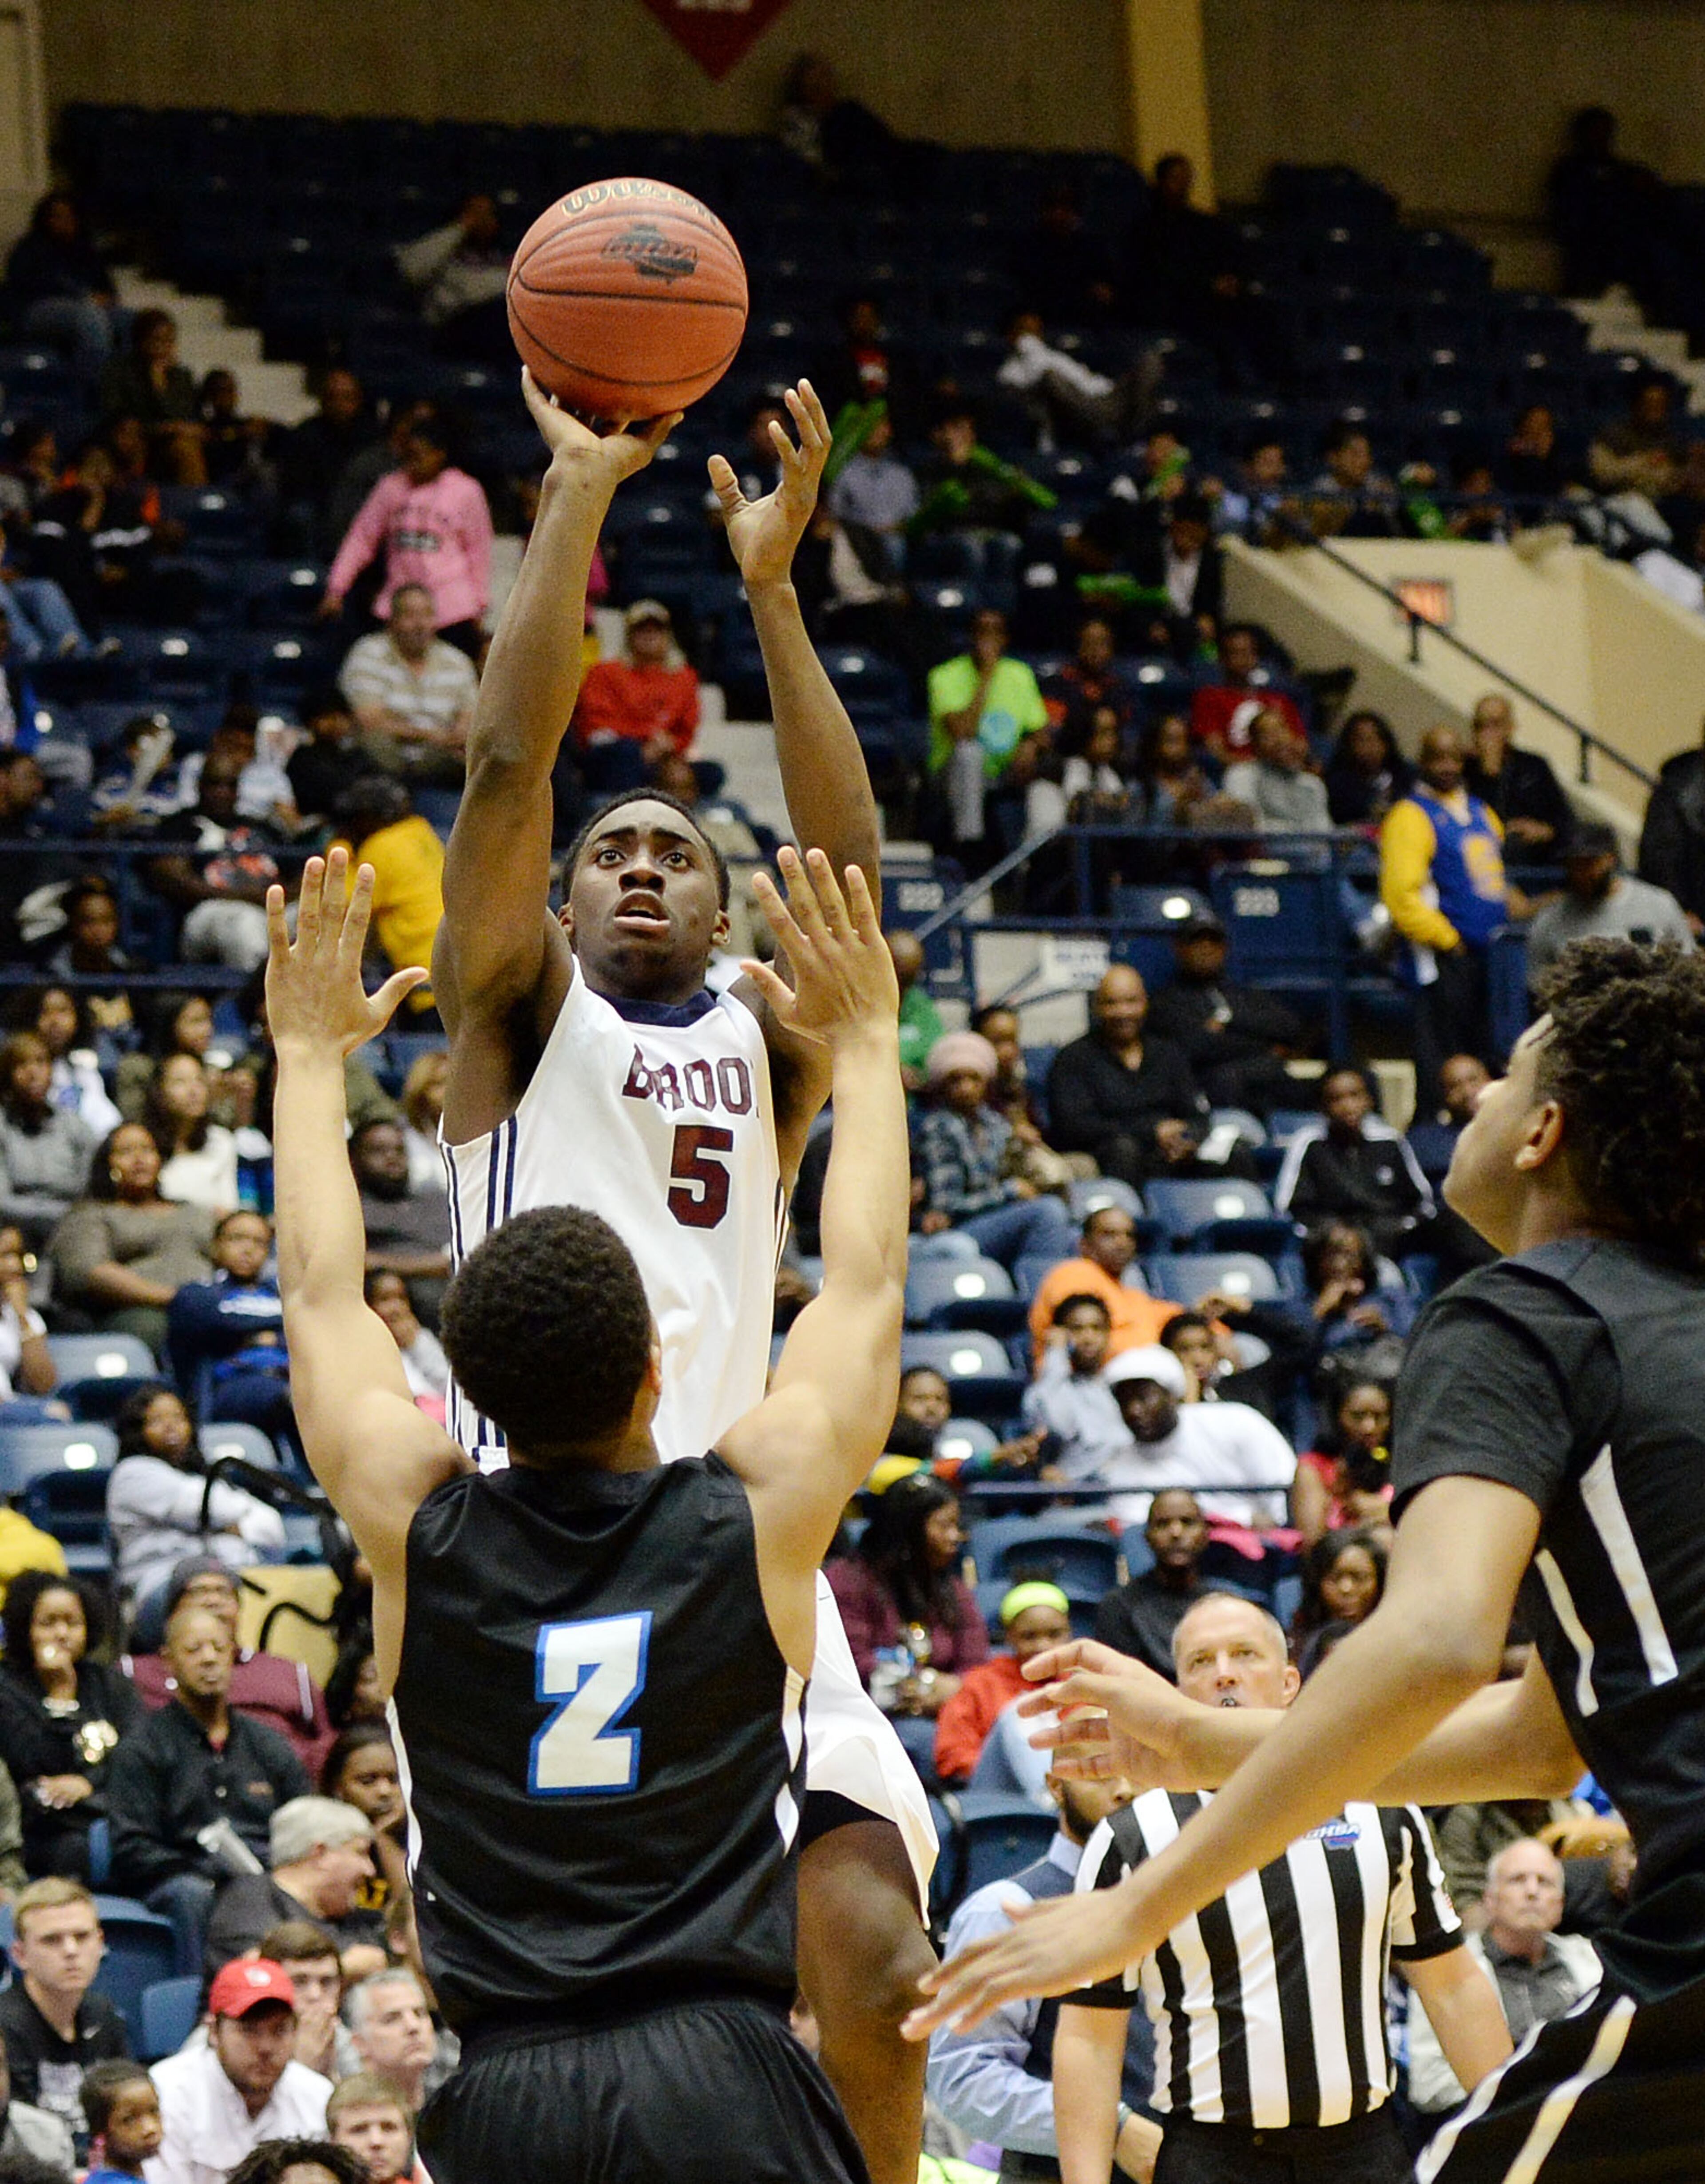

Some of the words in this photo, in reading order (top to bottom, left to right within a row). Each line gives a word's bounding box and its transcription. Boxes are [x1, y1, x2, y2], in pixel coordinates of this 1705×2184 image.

[622, 1043, 759, 1118] BROO
[667, 1124, 734, 1230] 5
[527, 1610, 654, 1796] 2
